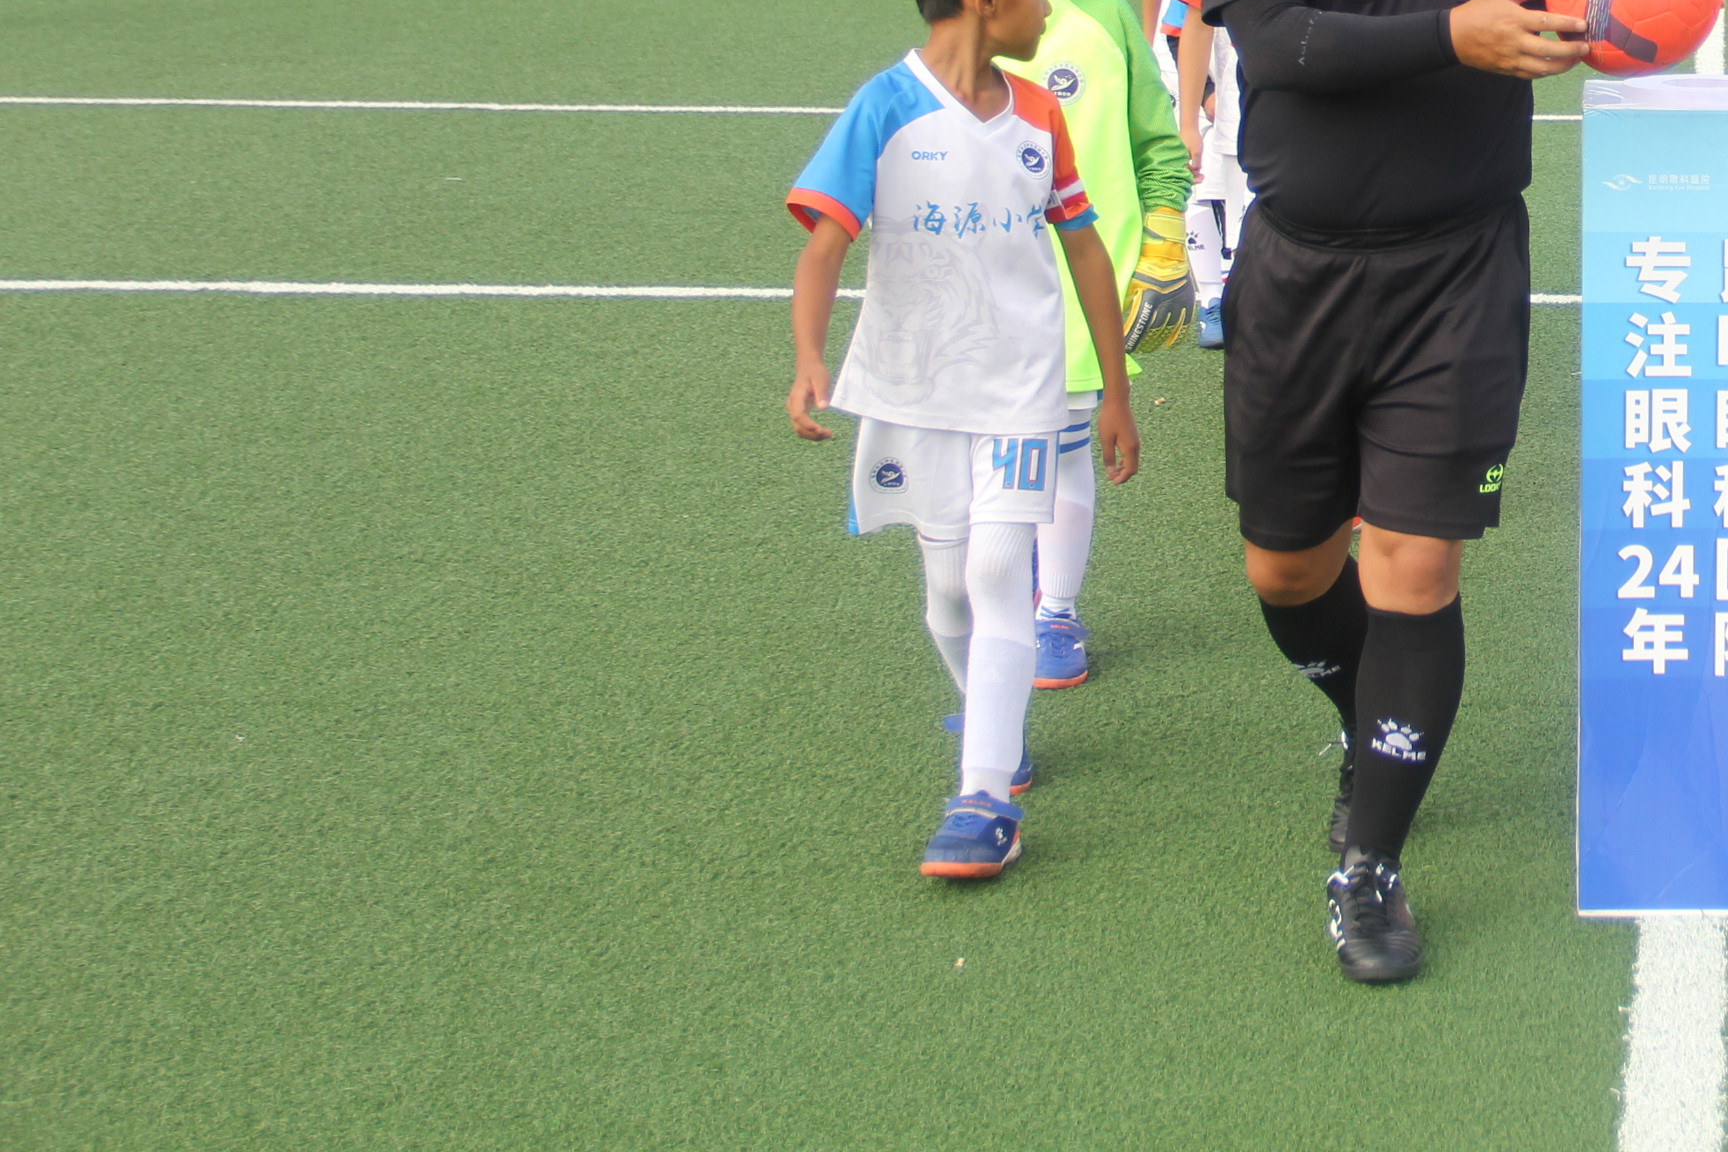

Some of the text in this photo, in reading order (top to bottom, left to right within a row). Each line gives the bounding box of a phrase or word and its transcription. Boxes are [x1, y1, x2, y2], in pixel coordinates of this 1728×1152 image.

[911, 151, 950, 161] ORKY
[1125, 301, 1154, 351] SHINESTONE
[993, 438, 1048, 491] 40
[1617, 236, 1699, 675] 专注眼科24年
[1371, 737, 1427, 762] KELME
